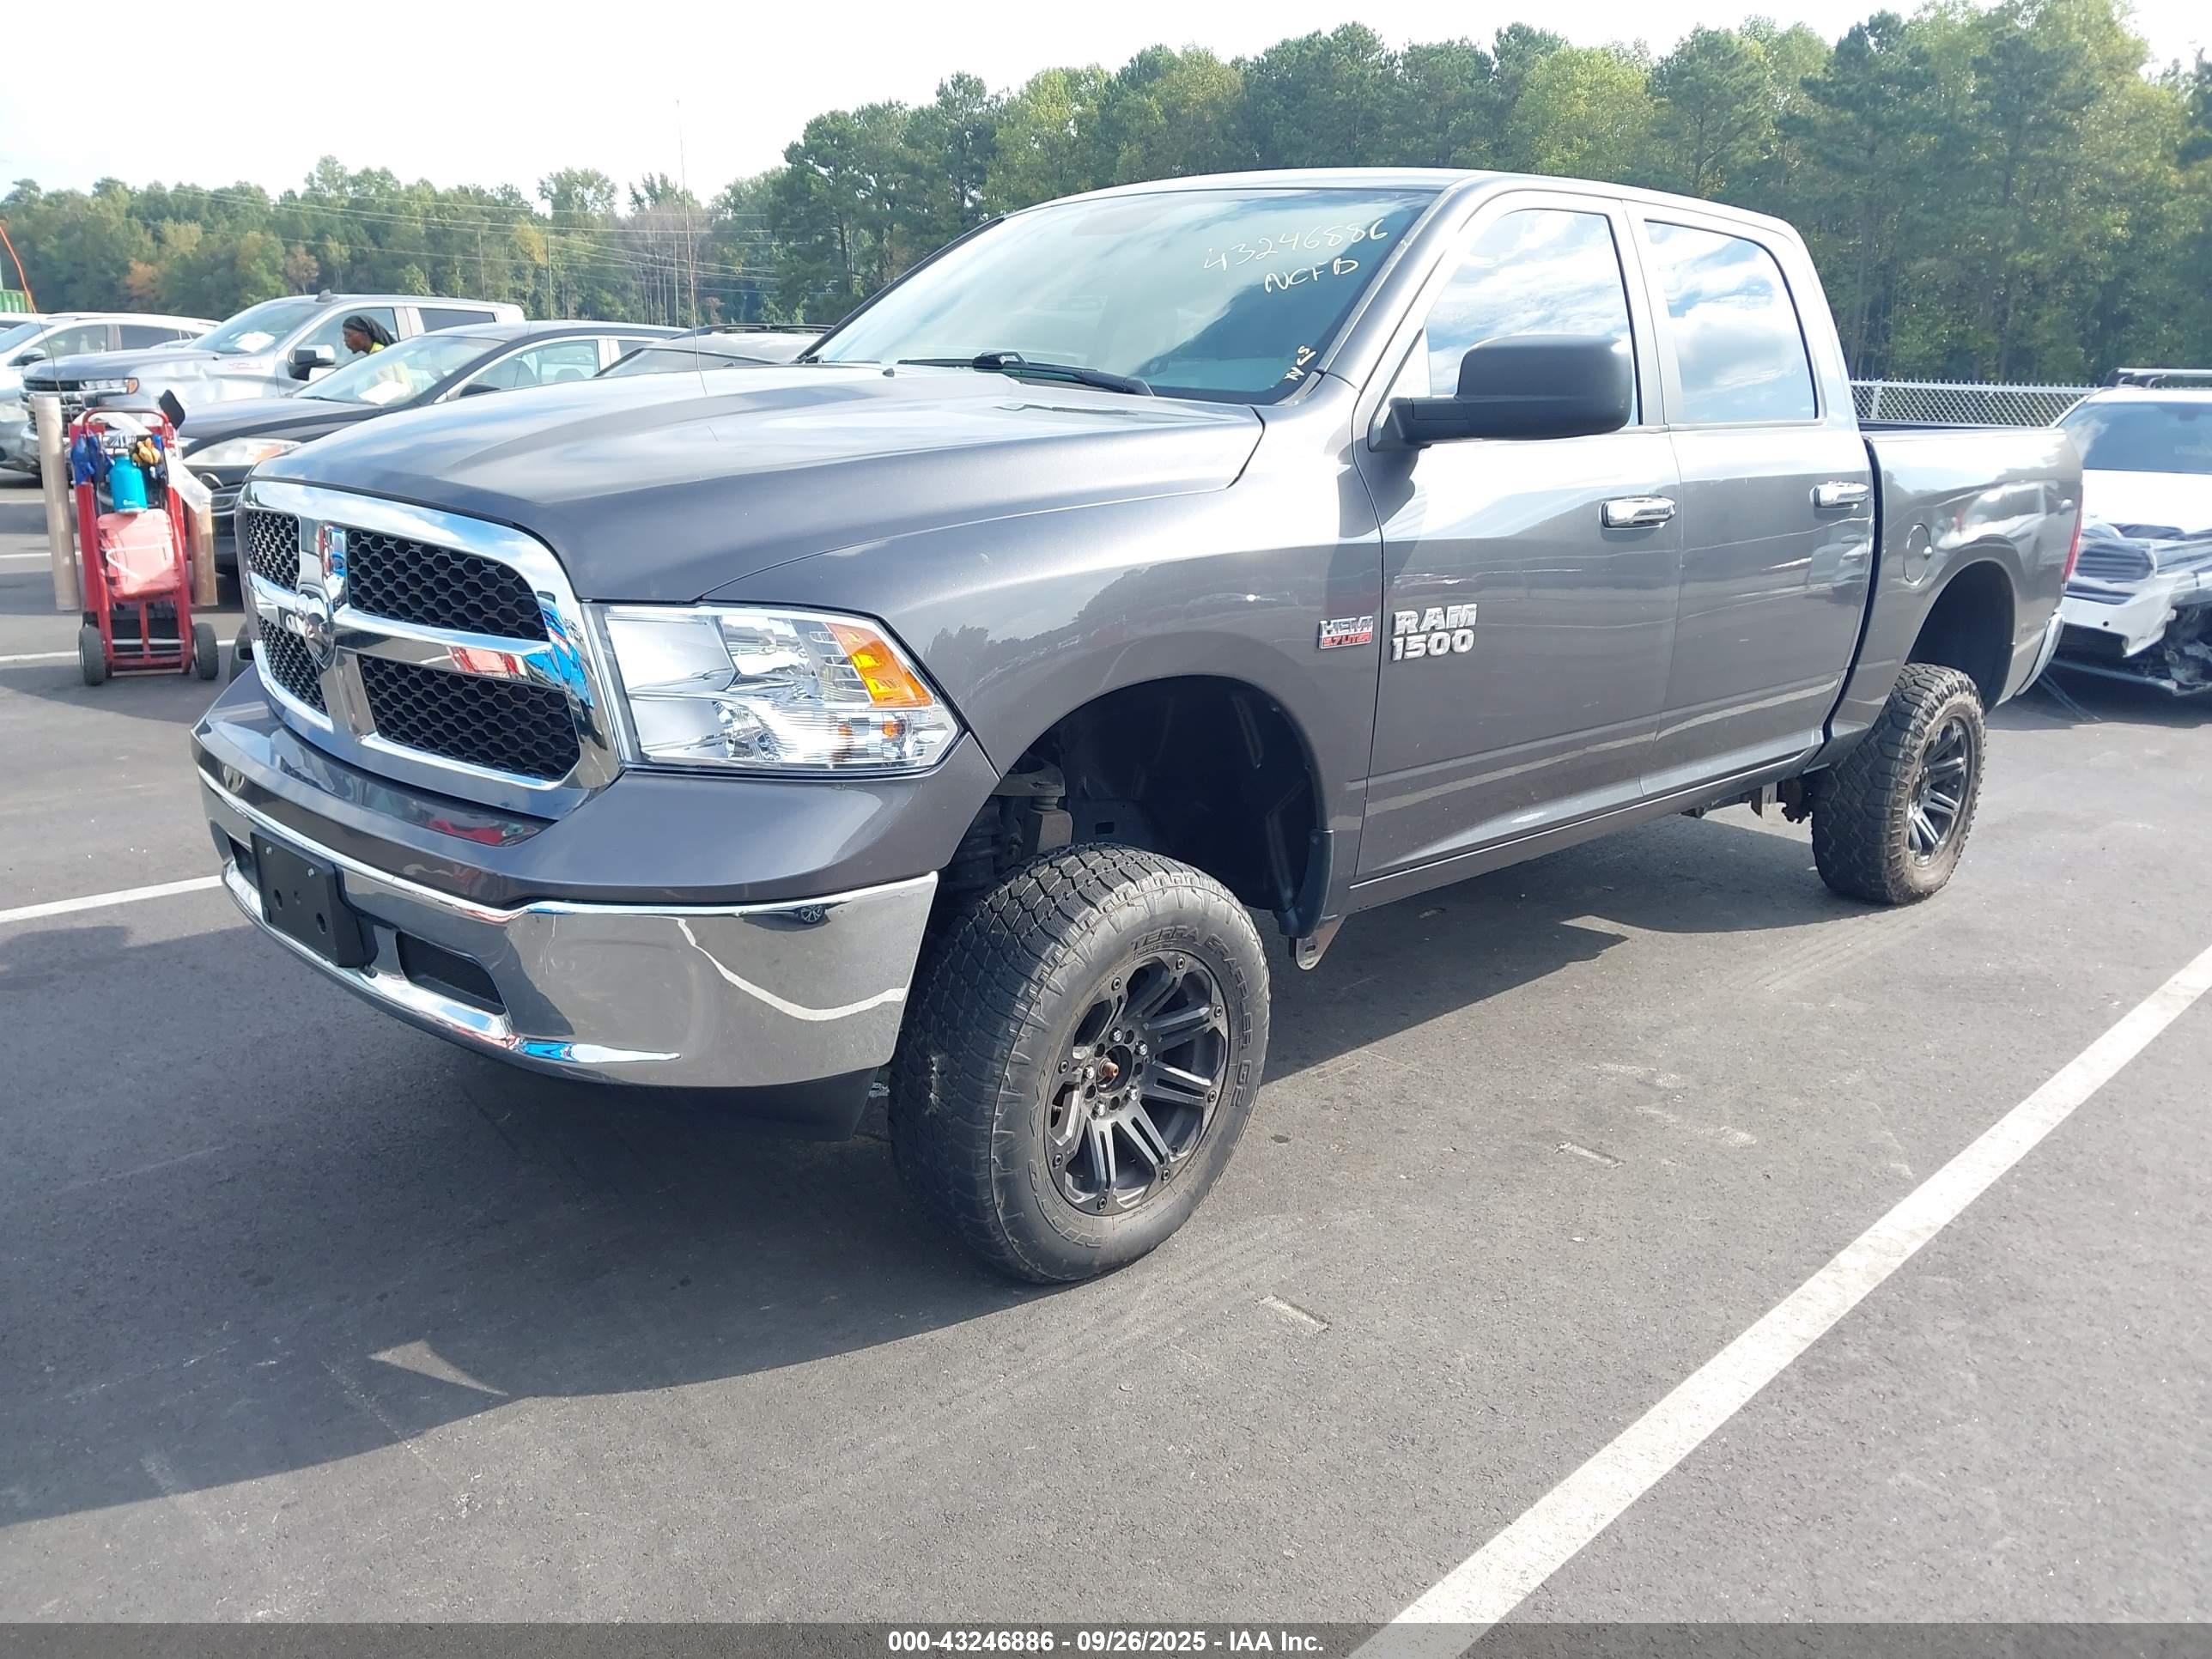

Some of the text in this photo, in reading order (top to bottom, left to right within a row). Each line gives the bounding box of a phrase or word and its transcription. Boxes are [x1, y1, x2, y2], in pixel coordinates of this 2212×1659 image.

[1320, 616, 1373, 636] HEMI
[1393, 604, 1478, 636] RAM
[1391, 629, 1475, 662] 1500
